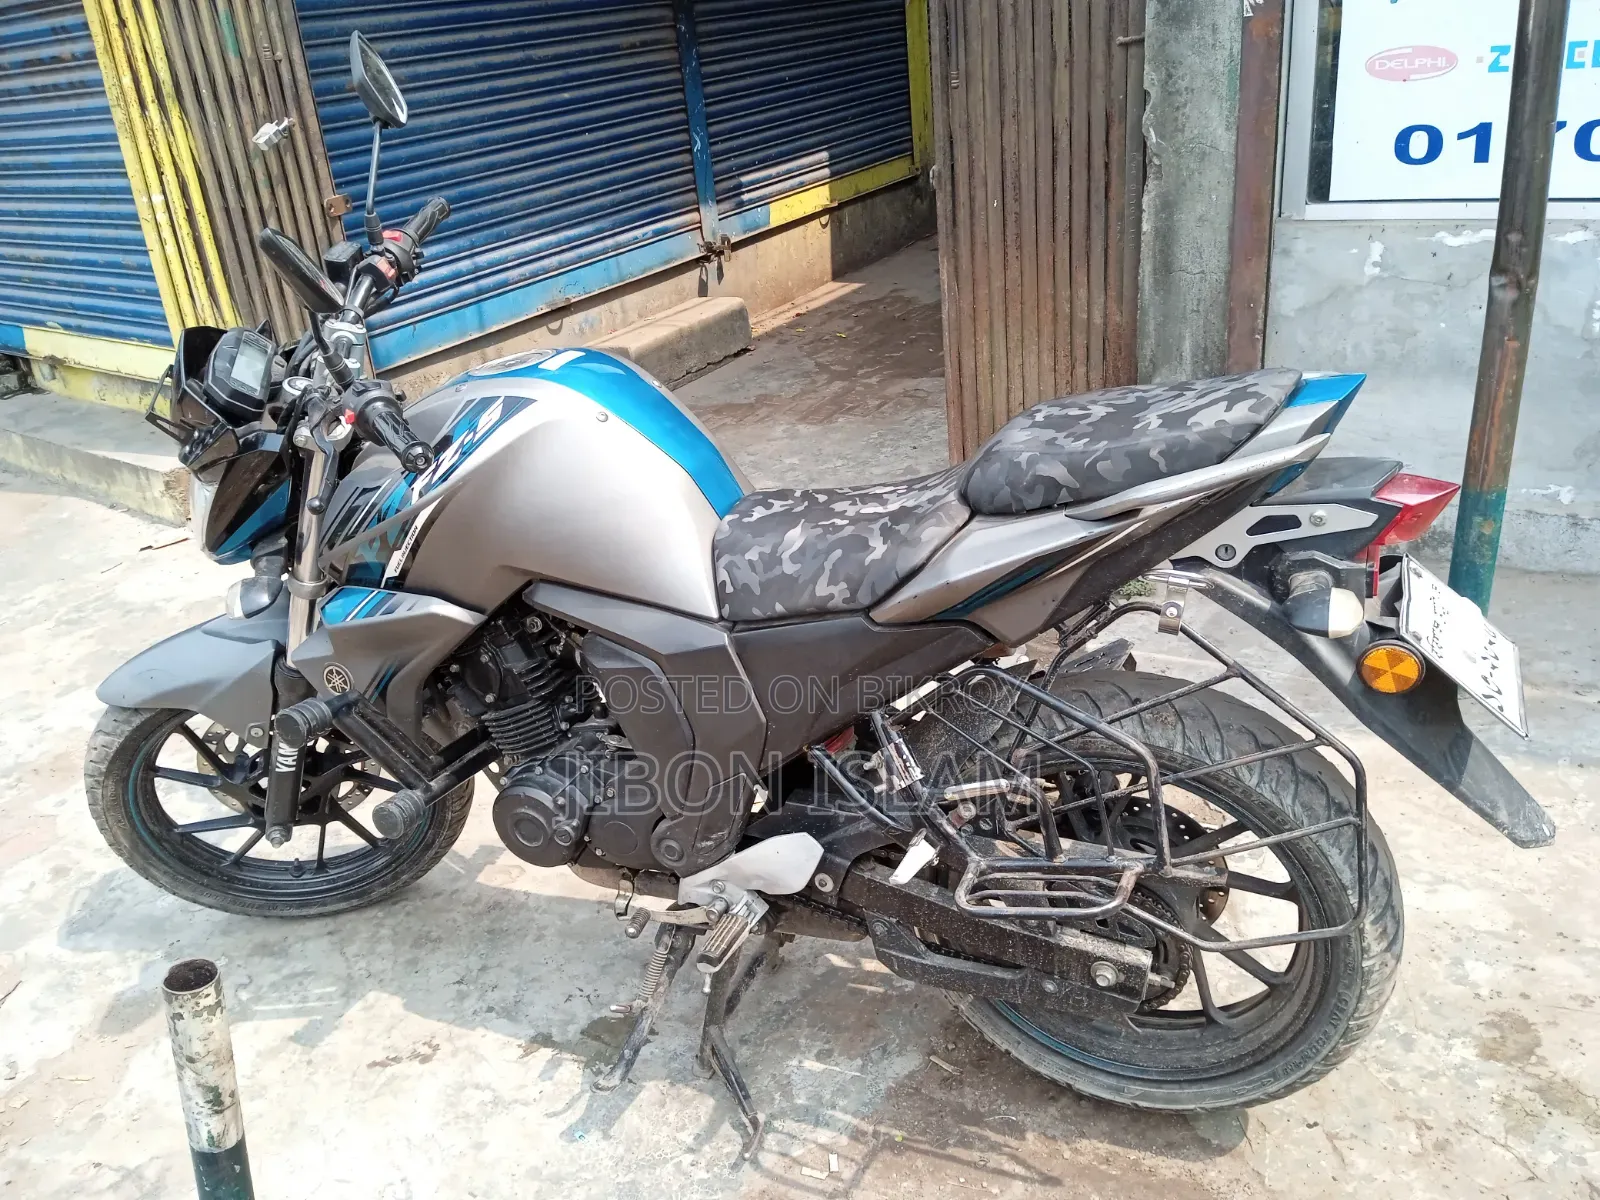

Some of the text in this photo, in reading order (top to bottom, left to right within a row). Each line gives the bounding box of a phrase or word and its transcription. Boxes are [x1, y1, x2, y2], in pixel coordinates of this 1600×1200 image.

[1375, 56, 1447, 70] DELPHI
[1394, 118, 1600, 166] 010
[275, 741, 299, 772] YAM
